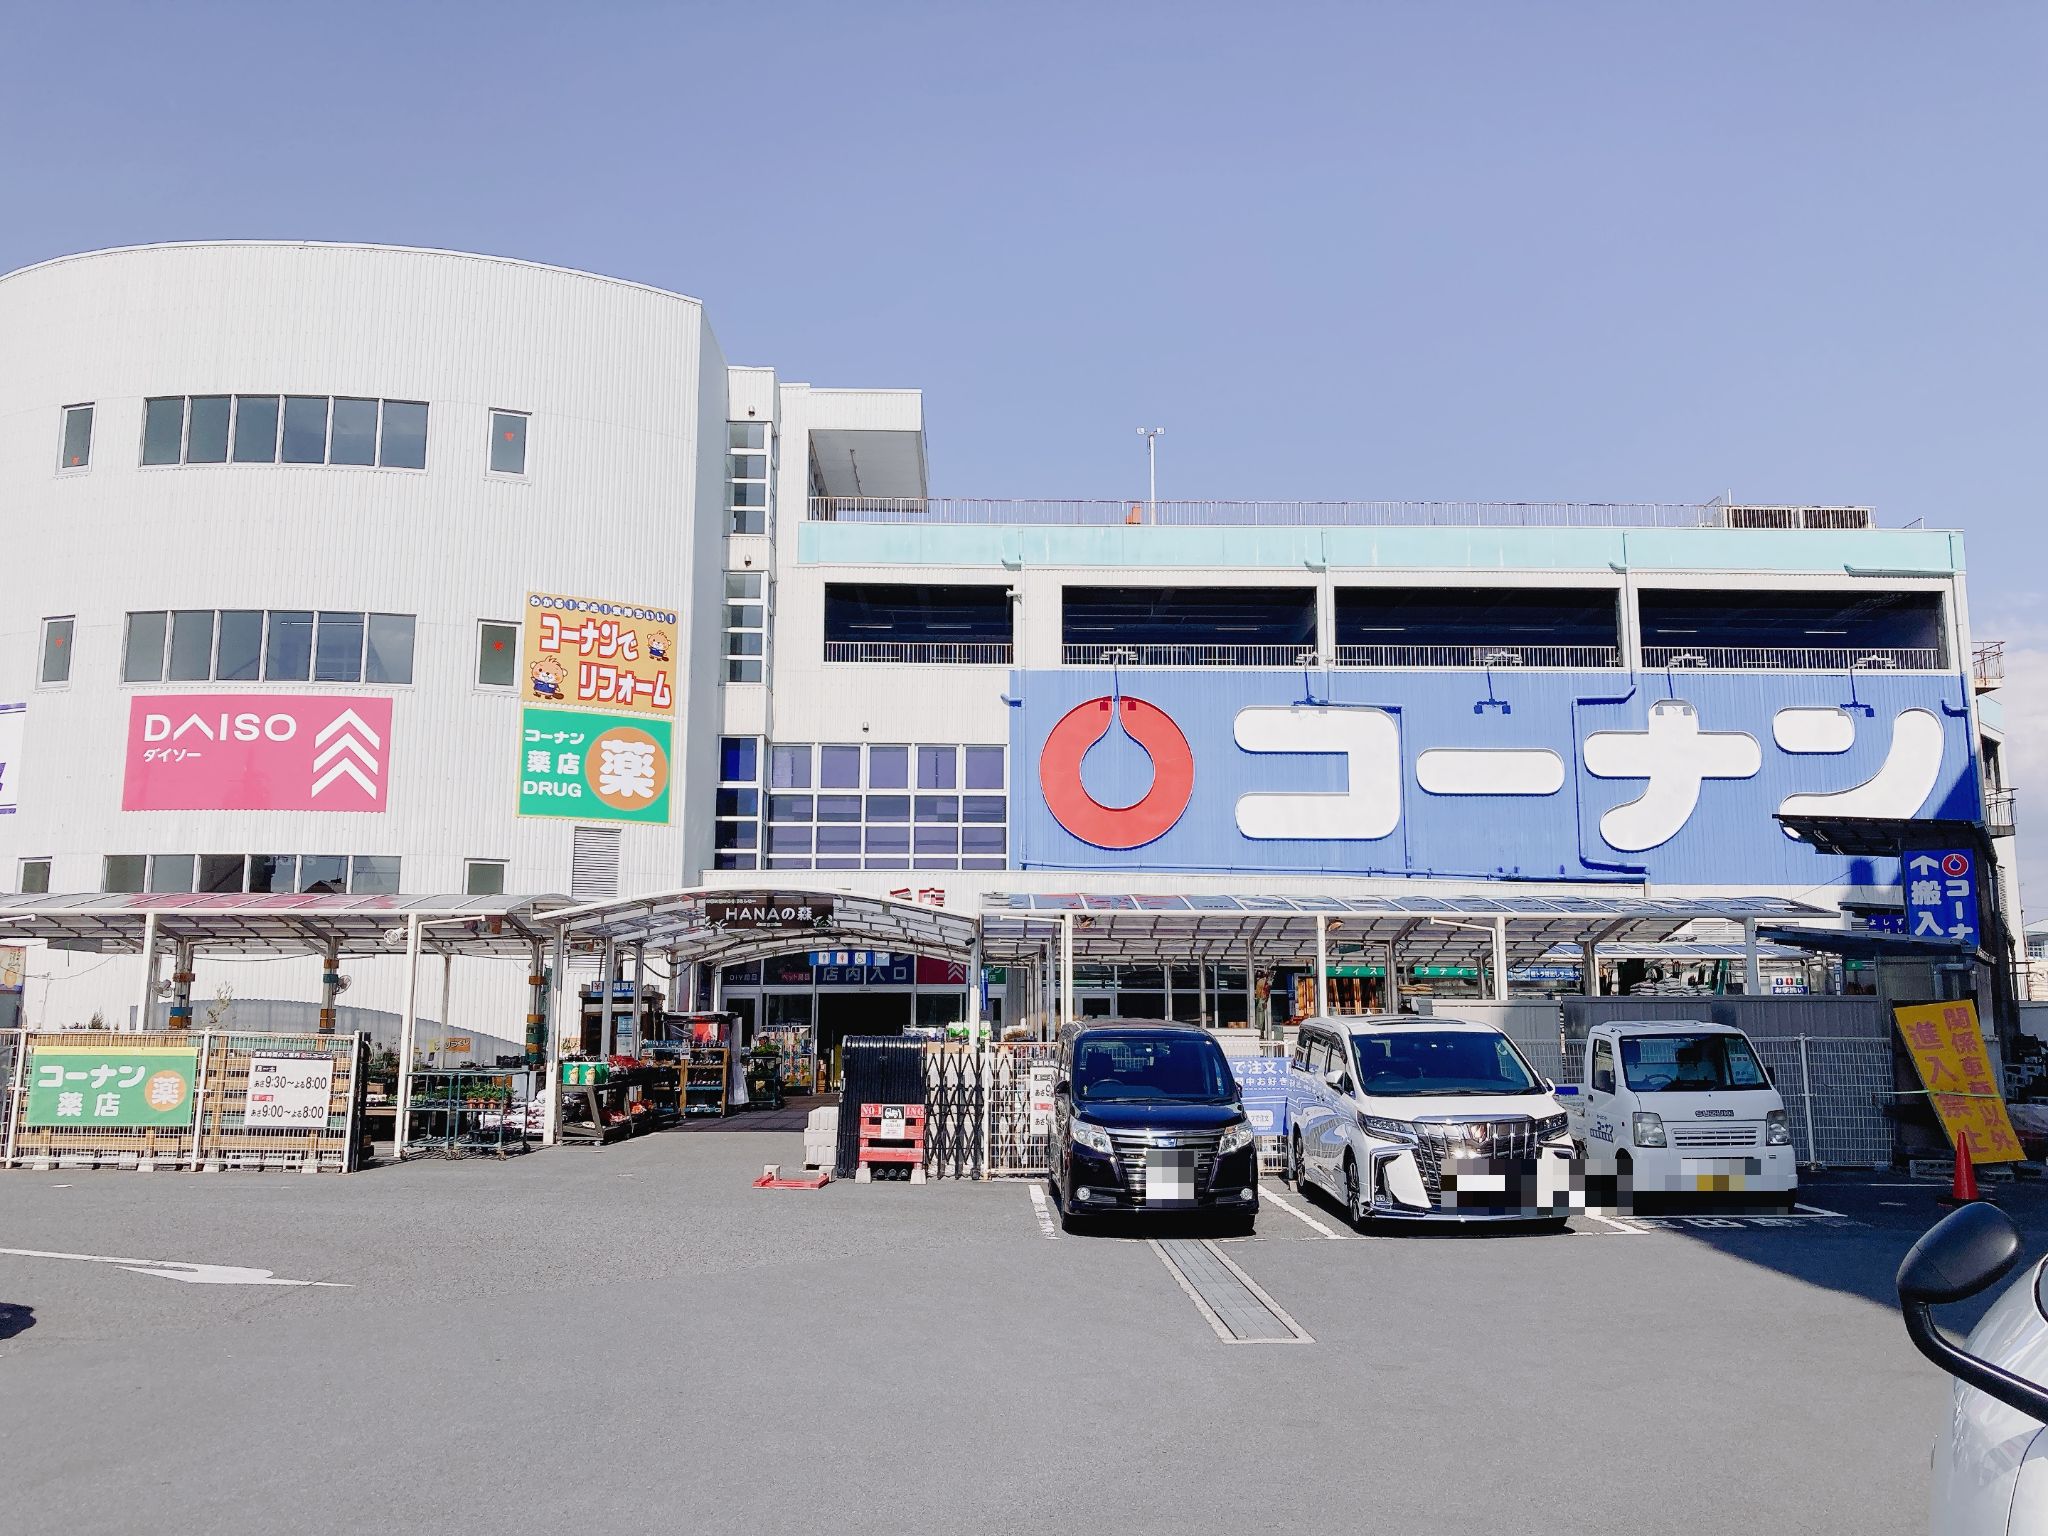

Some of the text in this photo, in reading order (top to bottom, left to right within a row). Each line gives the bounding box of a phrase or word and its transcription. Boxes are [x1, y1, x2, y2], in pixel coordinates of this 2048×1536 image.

[539, 612, 639, 661] コーナンで
[578, 661, 672, 708] リフォーム
[143, 713, 297, 742] DAISO
[524, 729, 585, 745] コーナン
[143, 748, 201, 762] ダイソー
[527, 750, 580, 775] 薬店
[599, 739, 656, 798] 薬
[1233, 698, 1945, 851] コーナン
[523, 780, 582, 798] DRUG
[725, 907, 813, 921] HANAの森
[1911, 880, 1944, 936] 搬入
[822, 966, 907, 982] 店内入口
[37, 1064, 146, 1089] コーナン
[151, 1077, 180, 1106] 薬
[56, 1092, 121, 1118] 薬店
